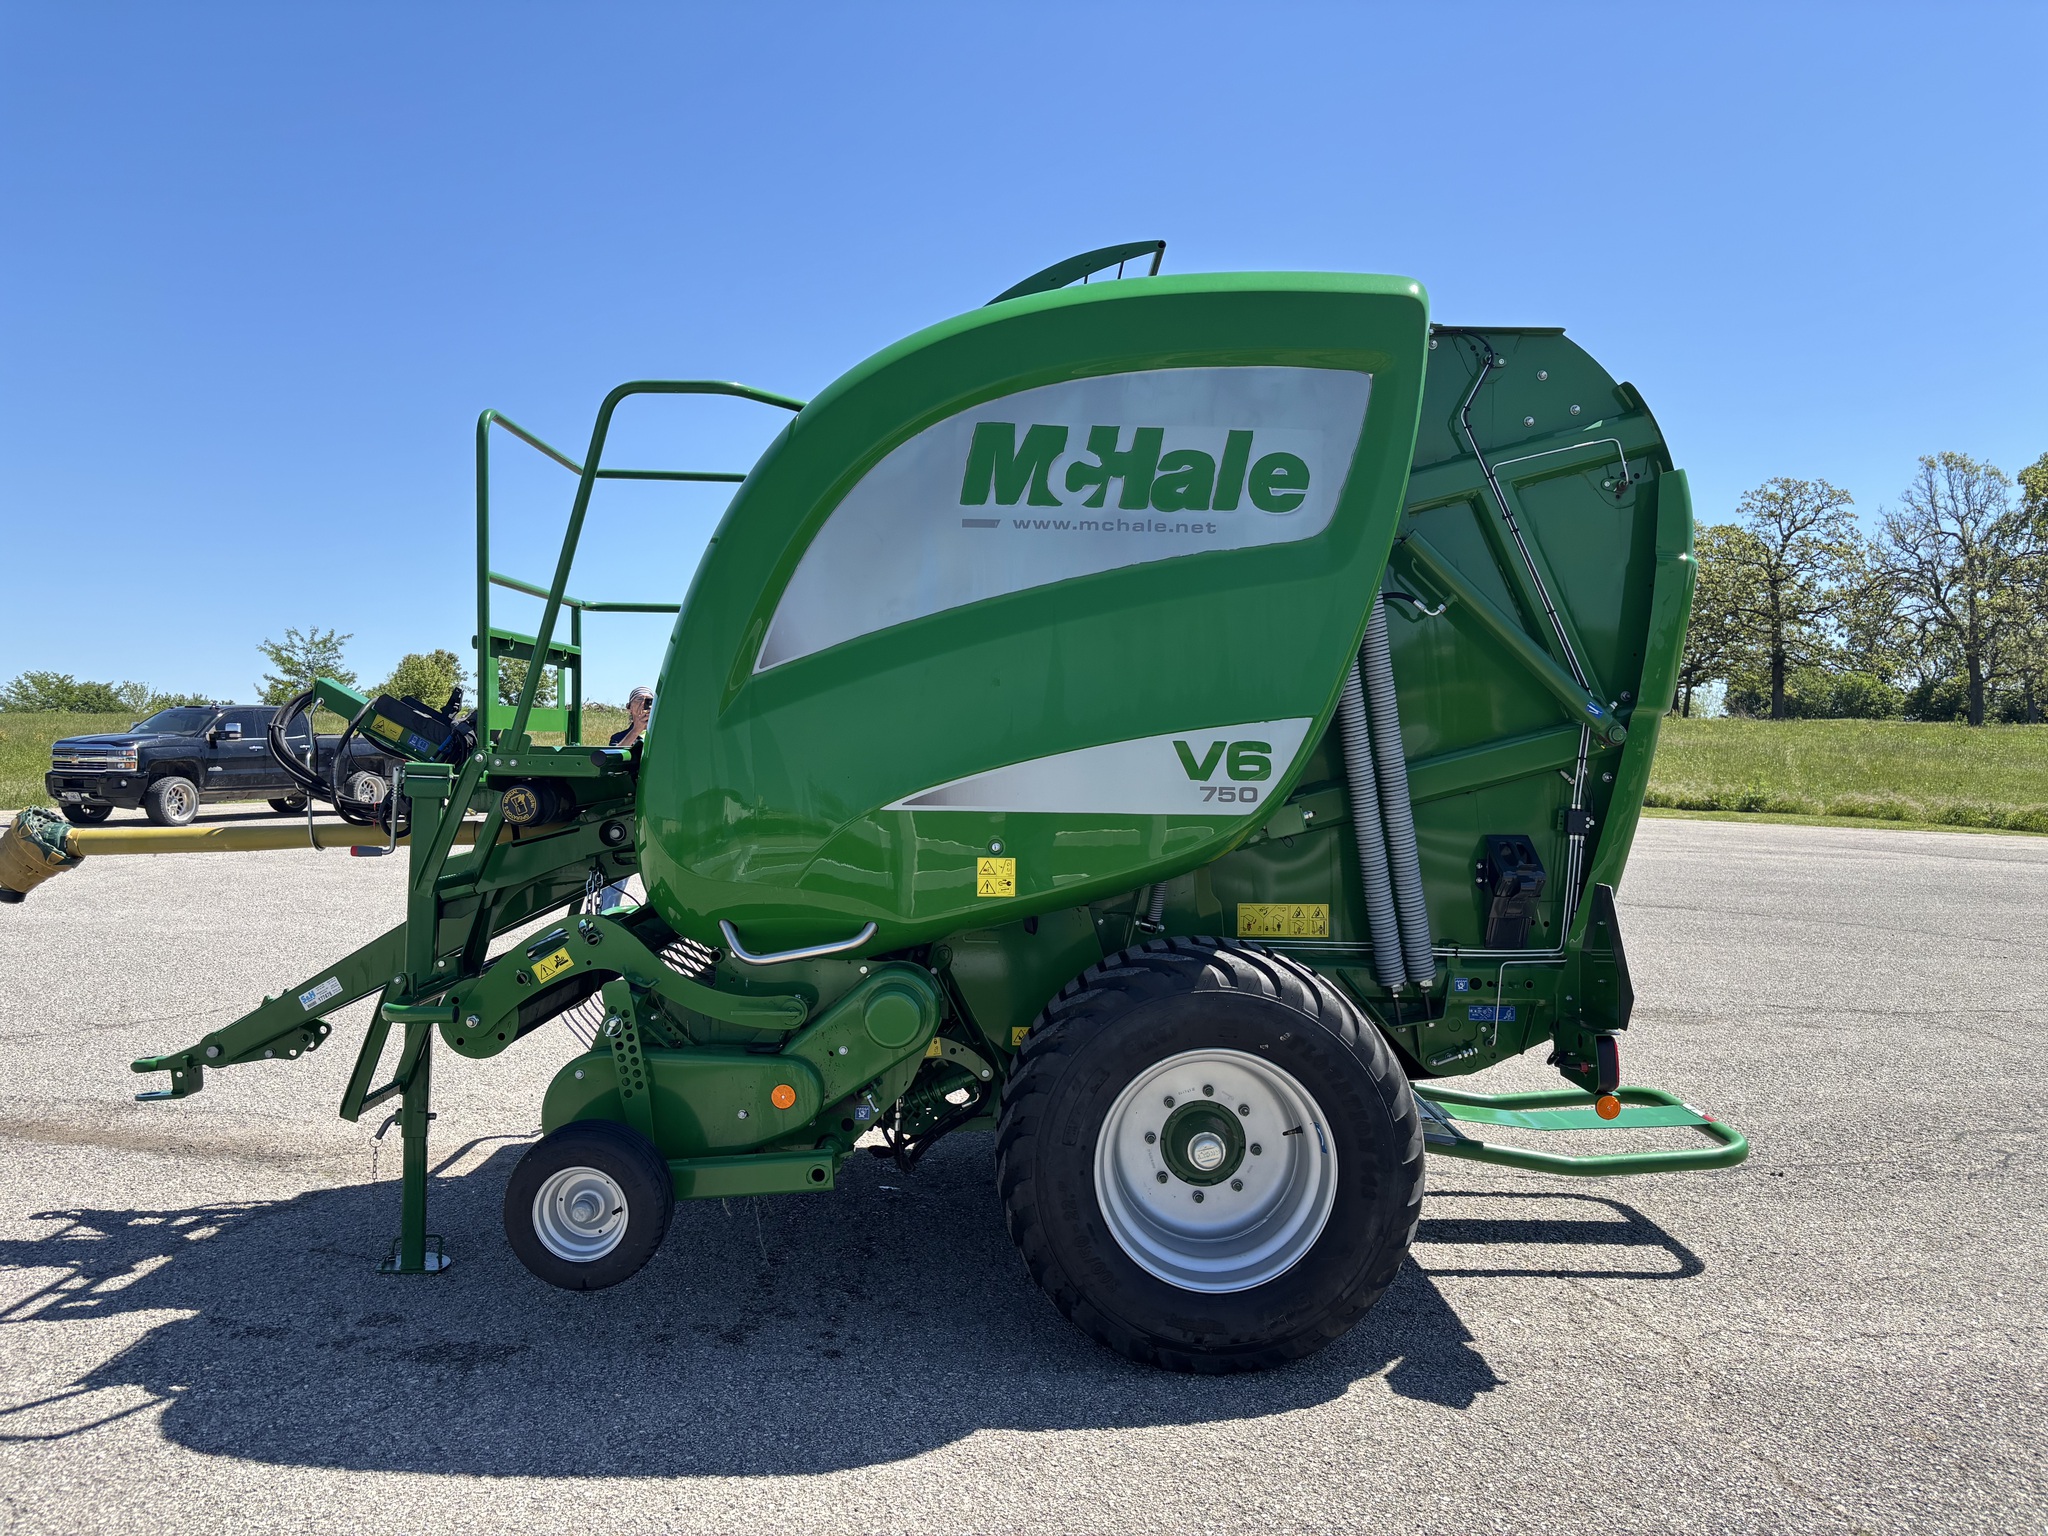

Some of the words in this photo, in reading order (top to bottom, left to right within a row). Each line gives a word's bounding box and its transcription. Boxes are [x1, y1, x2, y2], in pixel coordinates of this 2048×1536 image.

[960, 422, 1310, 513] McHale
[1012, 518, 1217, 534] www.mchale.net
[1172, 741, 1272, 781] V6
[1200, 787, 1258, 803] 750
